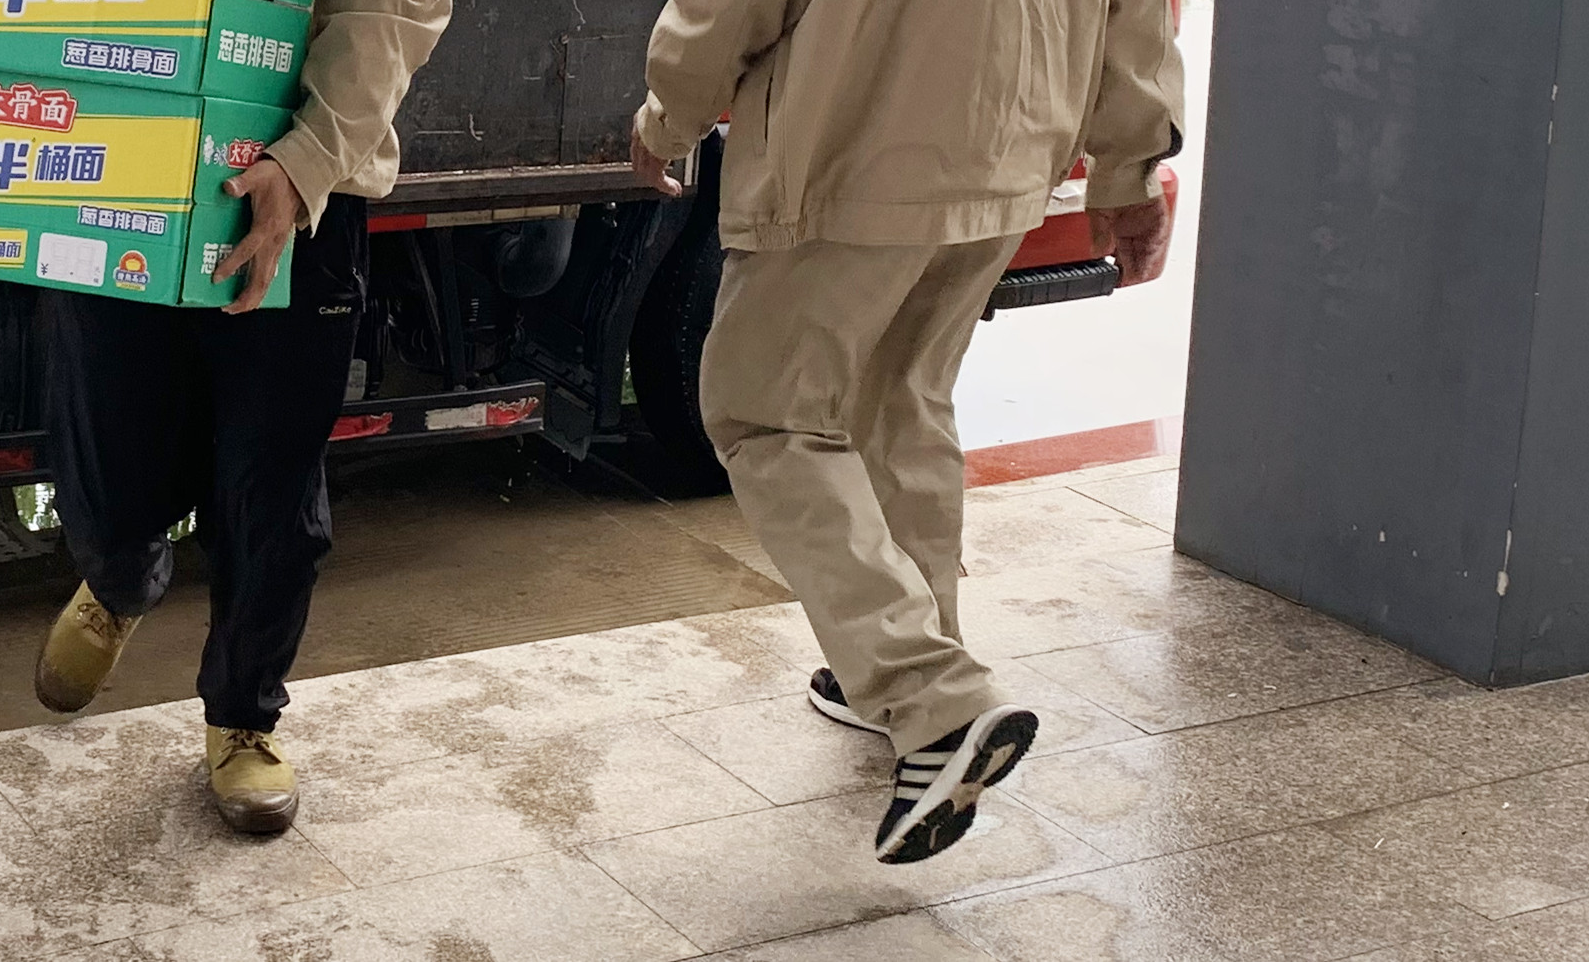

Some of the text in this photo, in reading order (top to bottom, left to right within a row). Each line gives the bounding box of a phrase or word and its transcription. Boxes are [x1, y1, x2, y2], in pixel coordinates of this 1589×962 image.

[64, 40, 178, 77] 葱香排骨面
[216, 28, 295, 74] 葱香排骨面
[79, 206, 168, 235] 葱香排骨面
